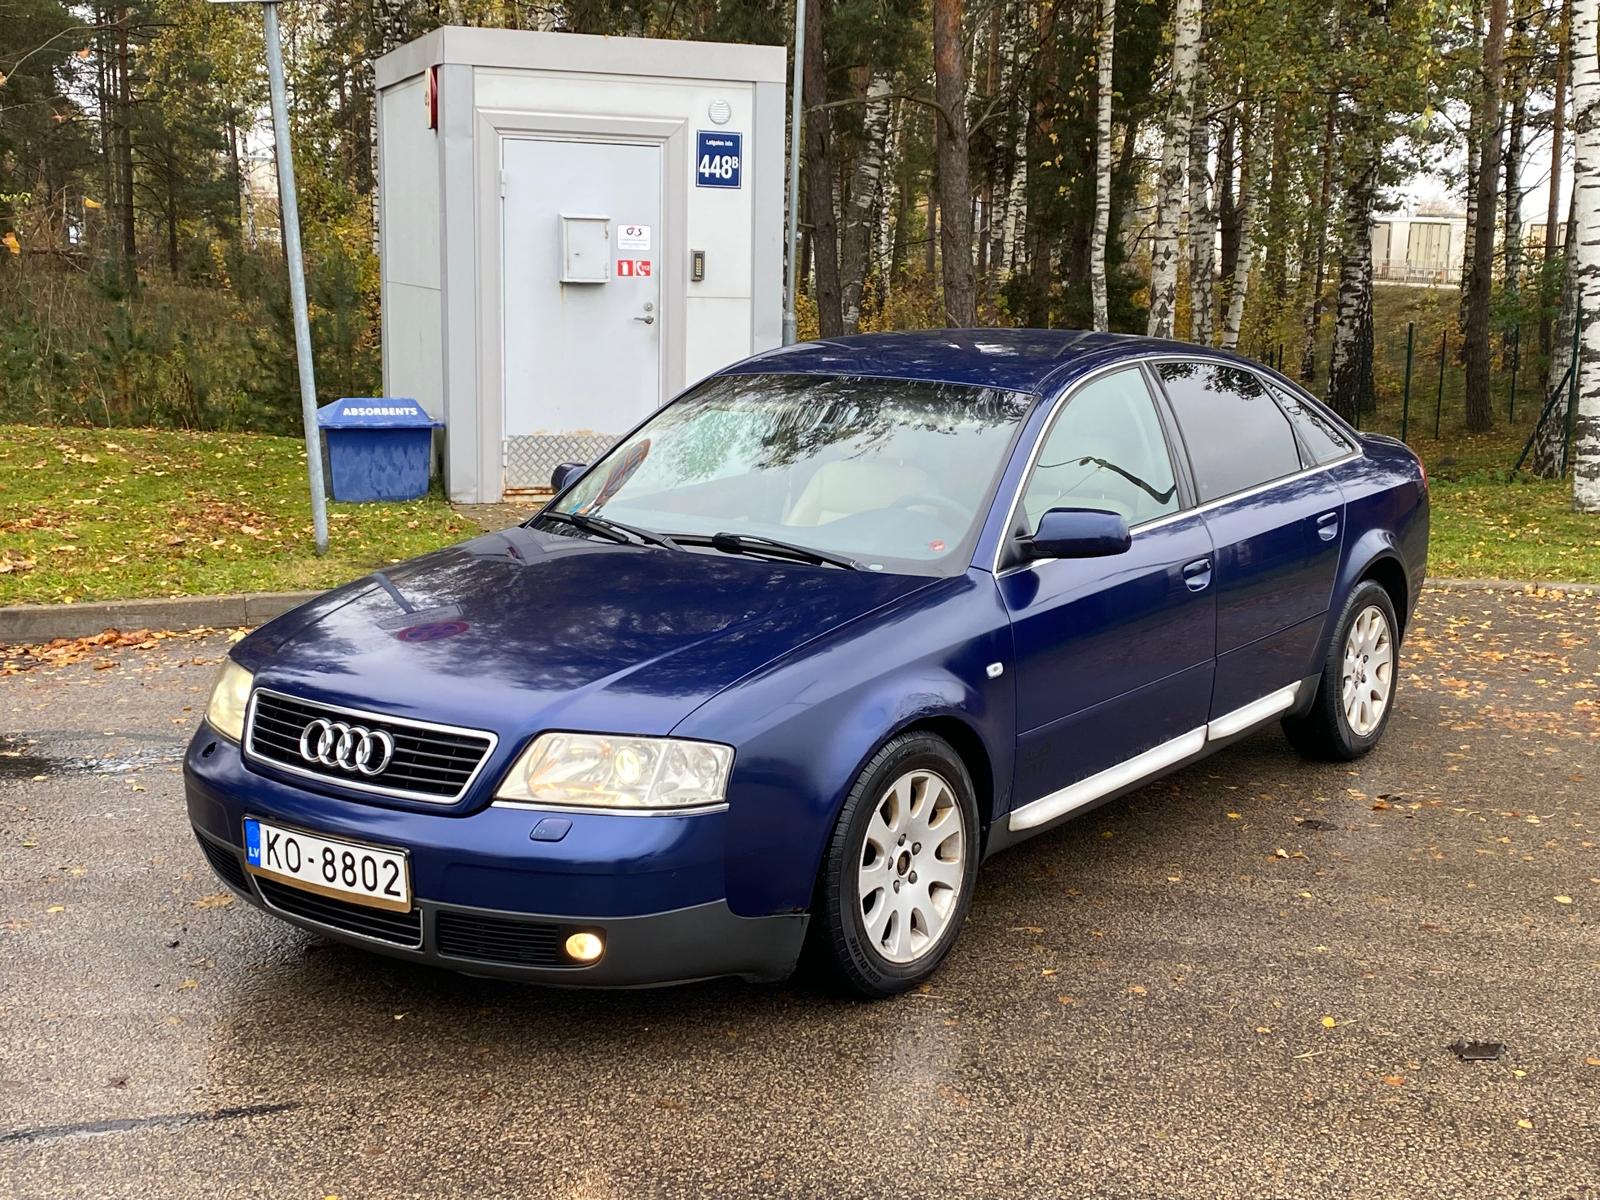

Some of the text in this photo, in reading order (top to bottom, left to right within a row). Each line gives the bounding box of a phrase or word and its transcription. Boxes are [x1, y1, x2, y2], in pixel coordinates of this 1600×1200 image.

[343, 407, 418, 416] ABSORBENTS
[249, 847, 259, 857] LV
[266, 830, 401, 896] KO-8802
